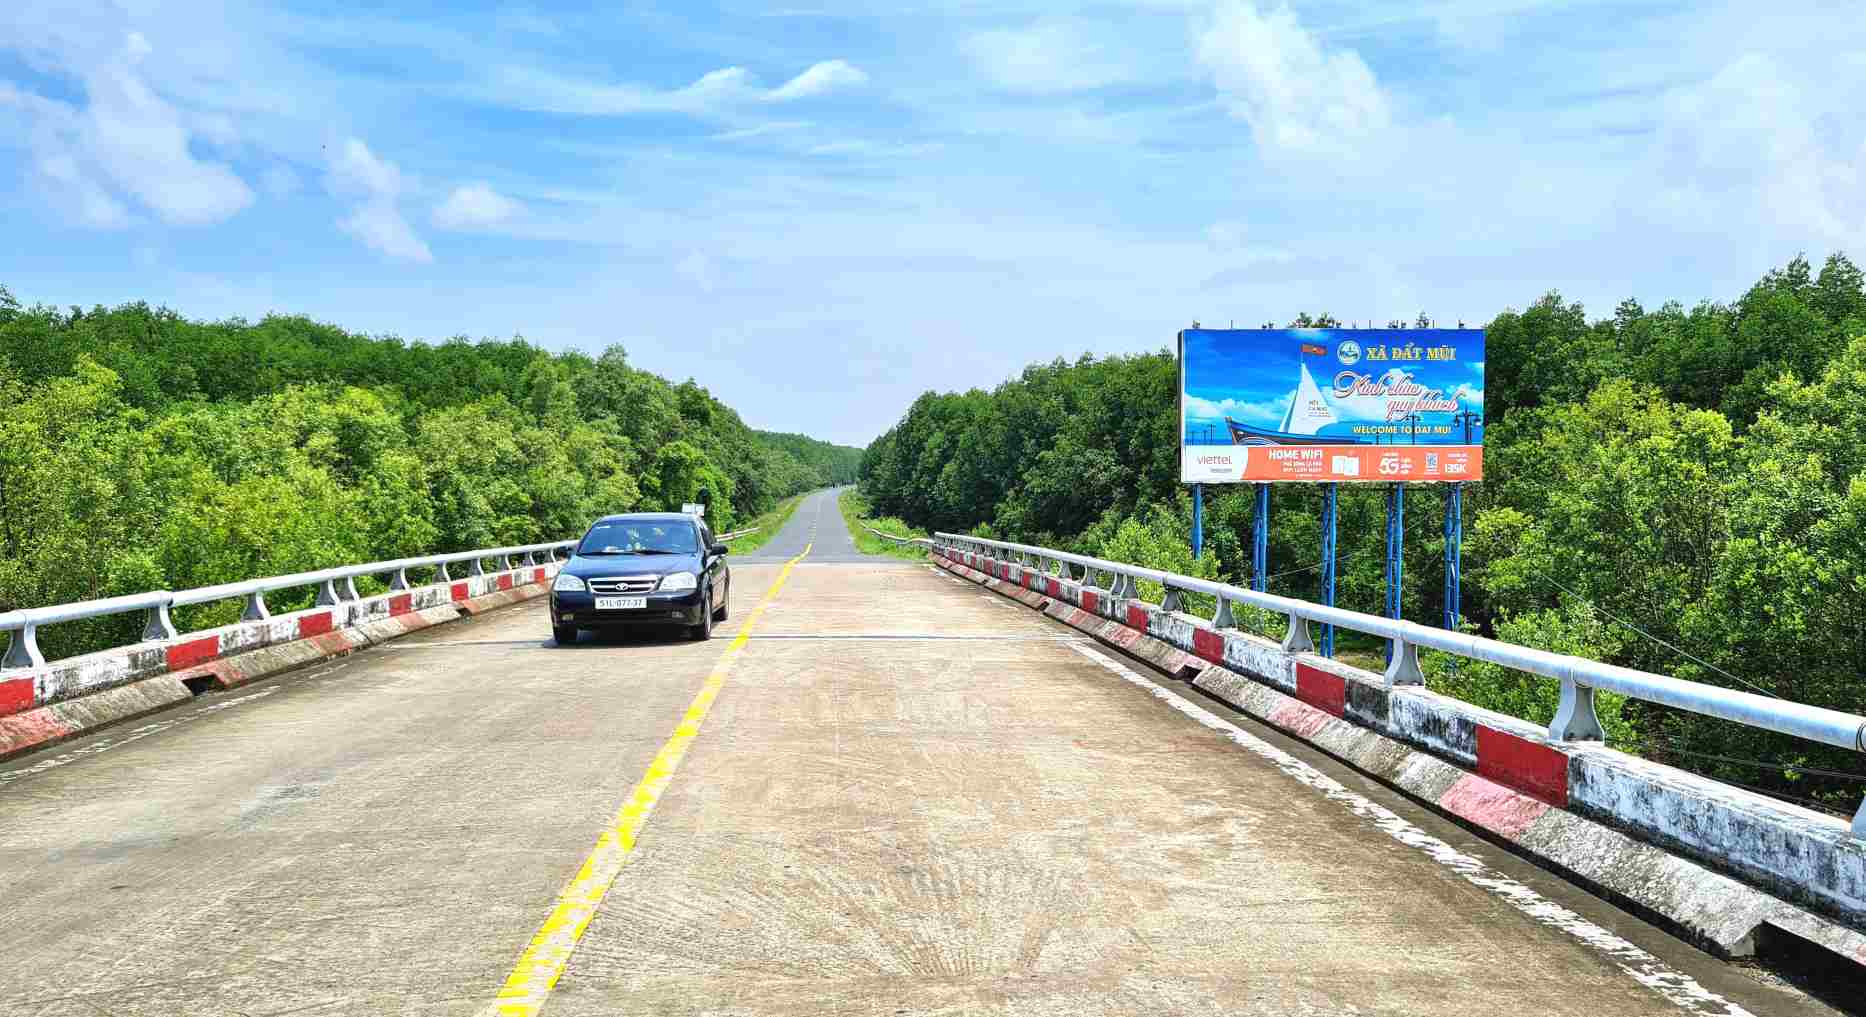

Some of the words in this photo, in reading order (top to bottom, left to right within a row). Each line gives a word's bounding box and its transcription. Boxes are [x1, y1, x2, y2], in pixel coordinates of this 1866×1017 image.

[1426, 344, 1457, 361] MŨI
[1353, 425, 1398, 434] WELCOME
[1401, 425, 1413, 434] TO
[1269, 449, 1299, 460] HOME
[1300, 449, 1323, 460] WIFI
[1378, 457, 1400, 475] 5G
